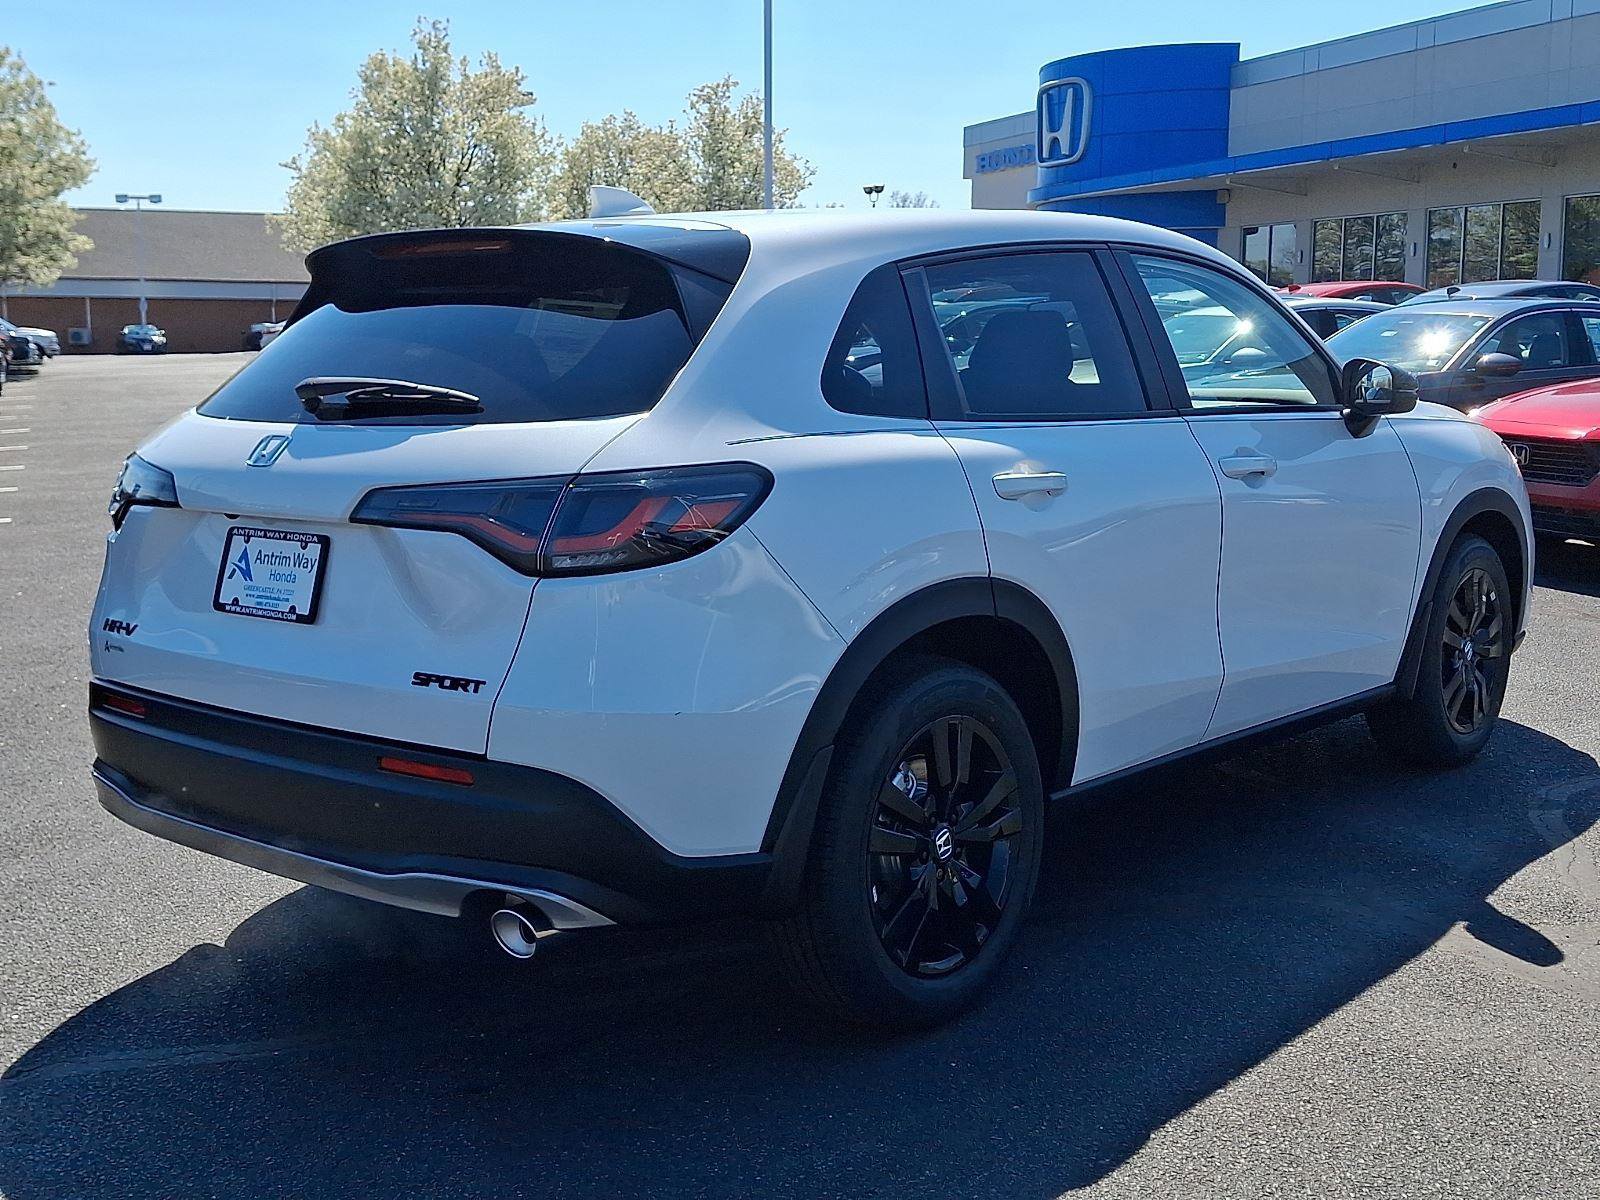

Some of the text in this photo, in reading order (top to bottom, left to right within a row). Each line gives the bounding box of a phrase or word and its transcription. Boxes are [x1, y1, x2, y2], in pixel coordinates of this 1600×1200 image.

[232, 528, 318, 543] ANTRIM WAY HONDA
[254, 549, 318, 574] Antrim Way
[269, 569, 297, 584] Honda
[225, 605, 297, 620] WWW.ANTRIMHONDA.COM
[103, 618, 138, 636] HR-V
[411, 671, 487, 694] SPORT
